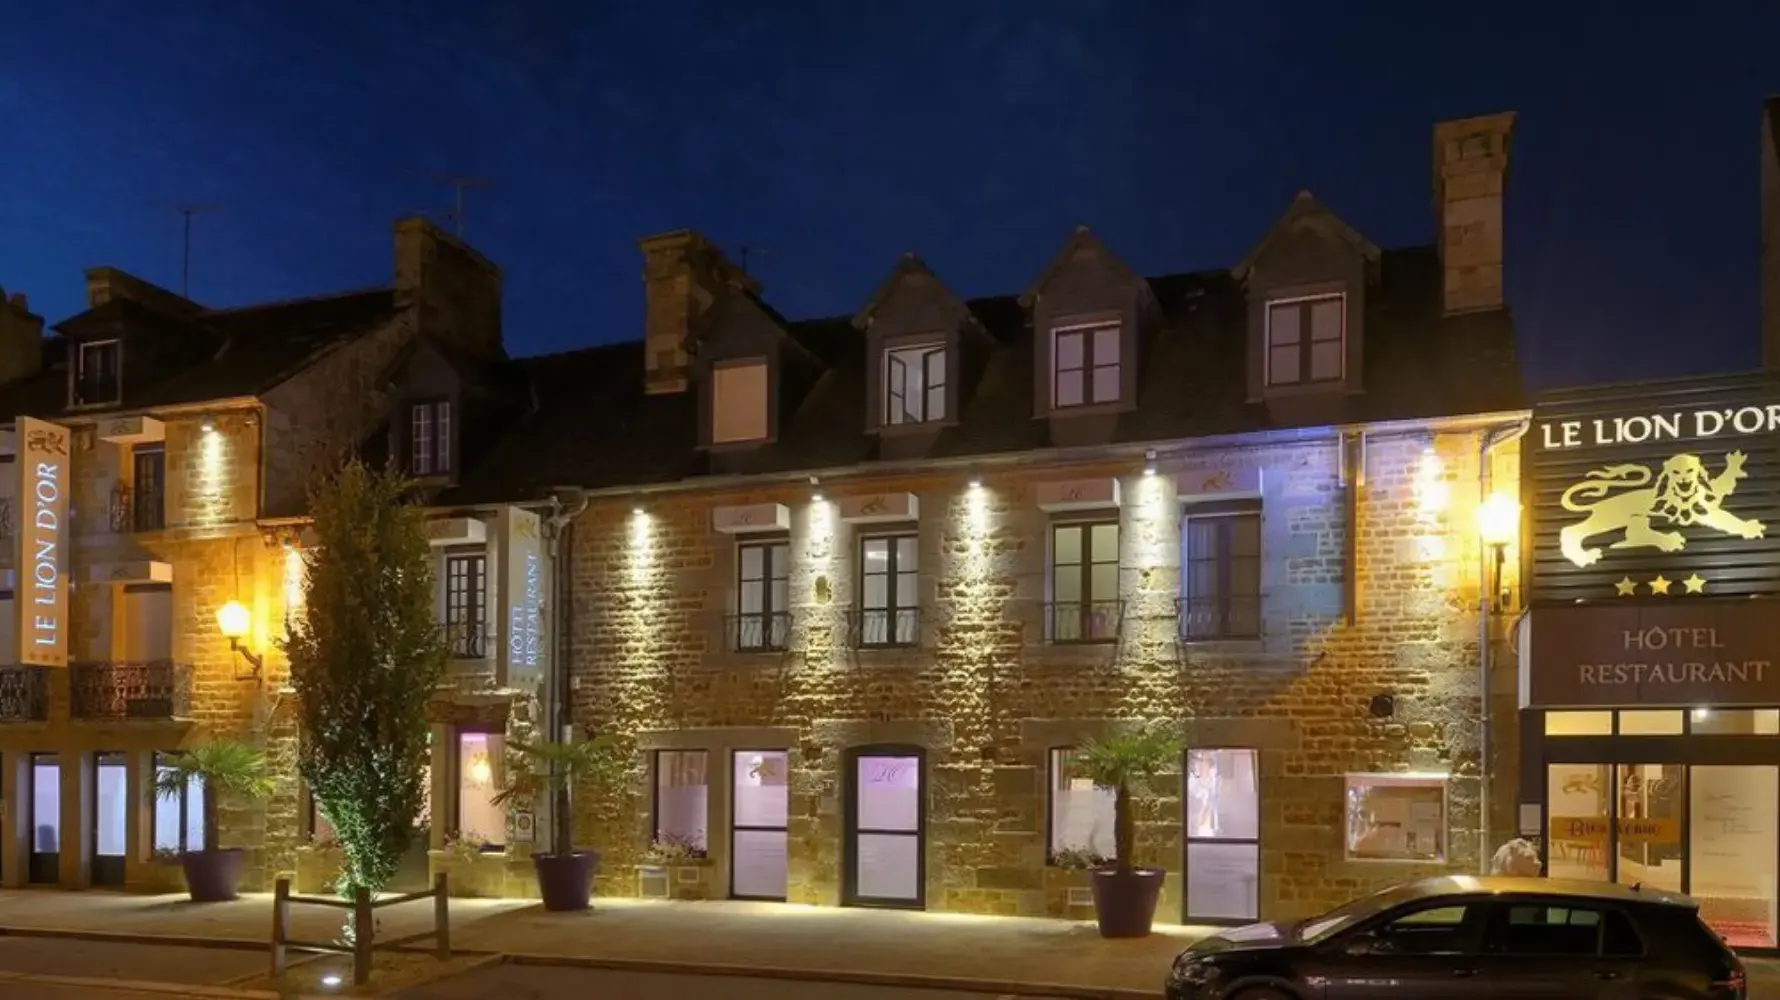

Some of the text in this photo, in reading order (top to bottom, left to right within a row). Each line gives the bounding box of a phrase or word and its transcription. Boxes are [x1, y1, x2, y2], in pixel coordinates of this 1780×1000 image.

[1540, 420, 1583, 449] LE
[1592, 412, 1683, 445] LION
[34, 462, 59, 646] LE LION D'OR
[526, 551, 539, 666] RESTAURANT
[1622, 625, 1726, 651] HÔTEL
[1577, 659, 1772, 685] RESTAURANT
